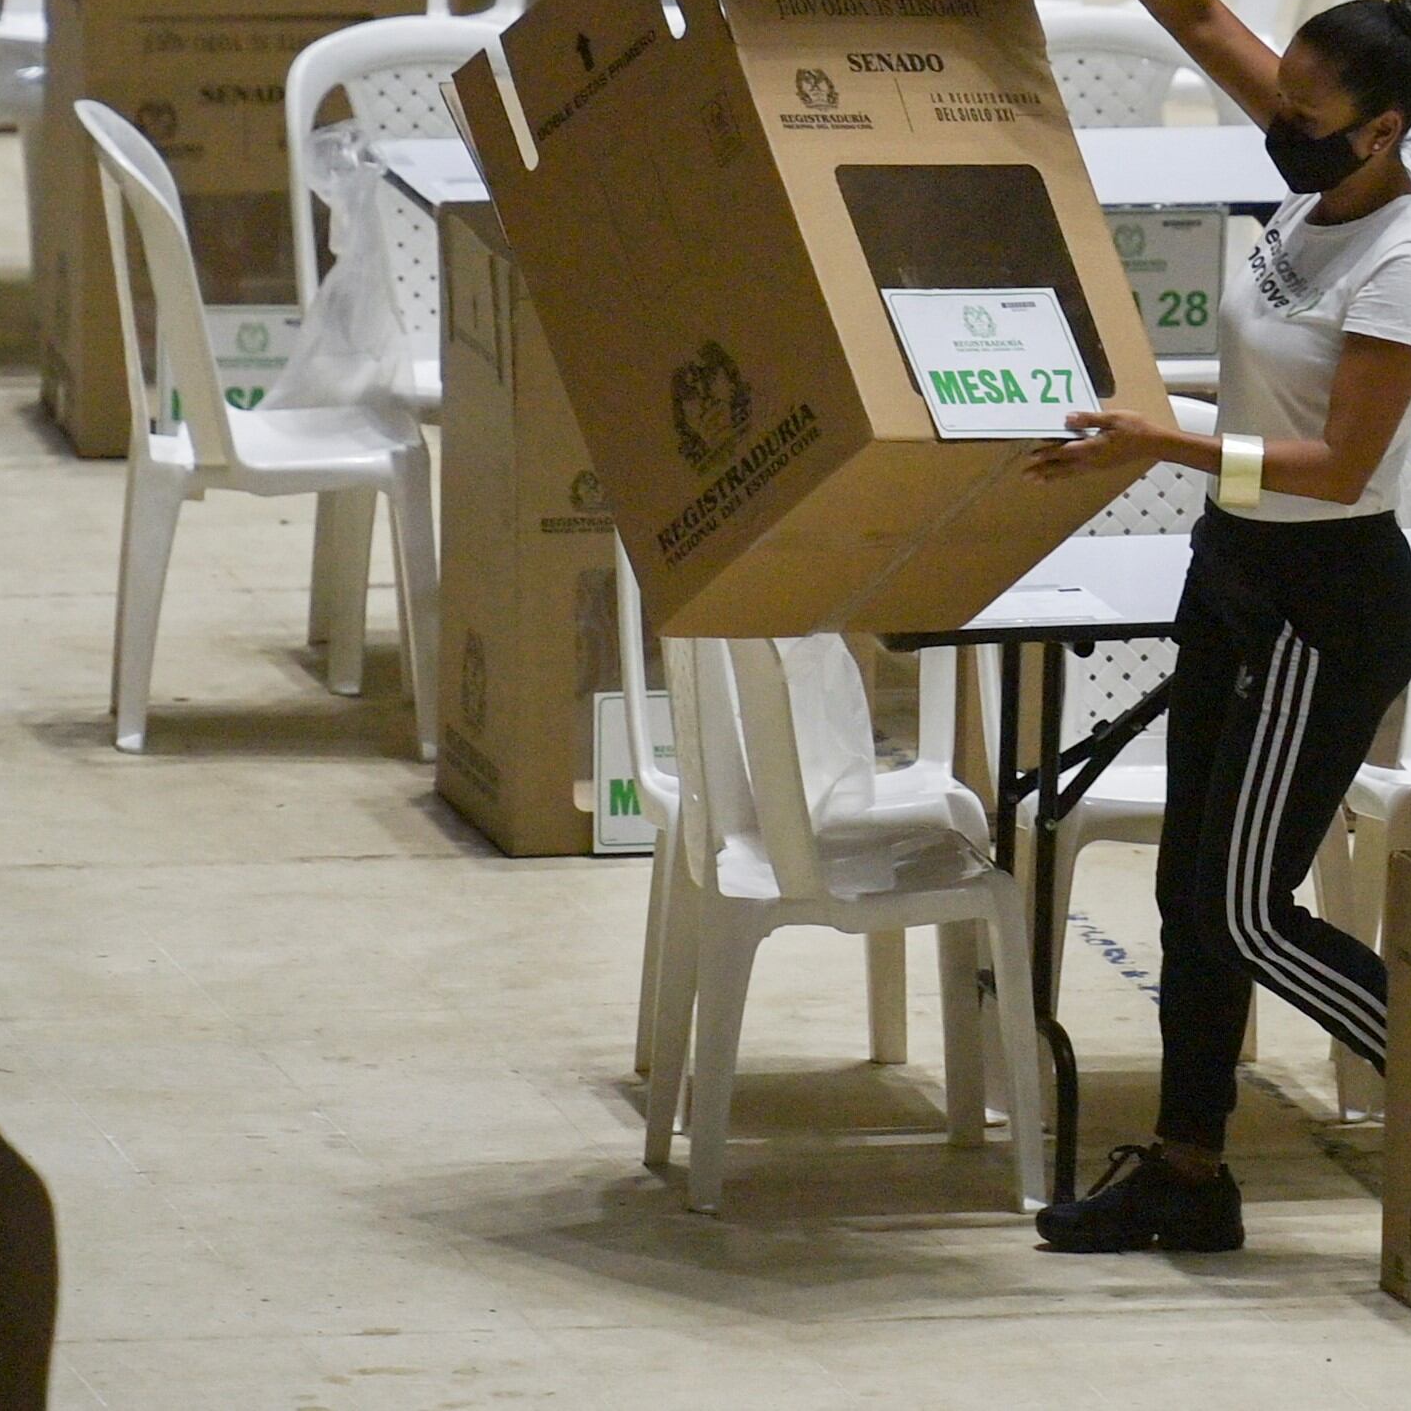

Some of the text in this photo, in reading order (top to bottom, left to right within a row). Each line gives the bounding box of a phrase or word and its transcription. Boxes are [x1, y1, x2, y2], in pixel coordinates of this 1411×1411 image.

[848, 53, 944, 73] SENADO
[780, 110, 872, 124] REGISTRADURÍA
[935, 108, 1016, 122] DEL SIGLO XXI
[1158, 290, 1208, 327] 28
[928, 369, 1074, 404] MESA 27
[657, 403, 816, 554] REGISTRADURÍA
[745, 453, 788, 497] ESTADO
